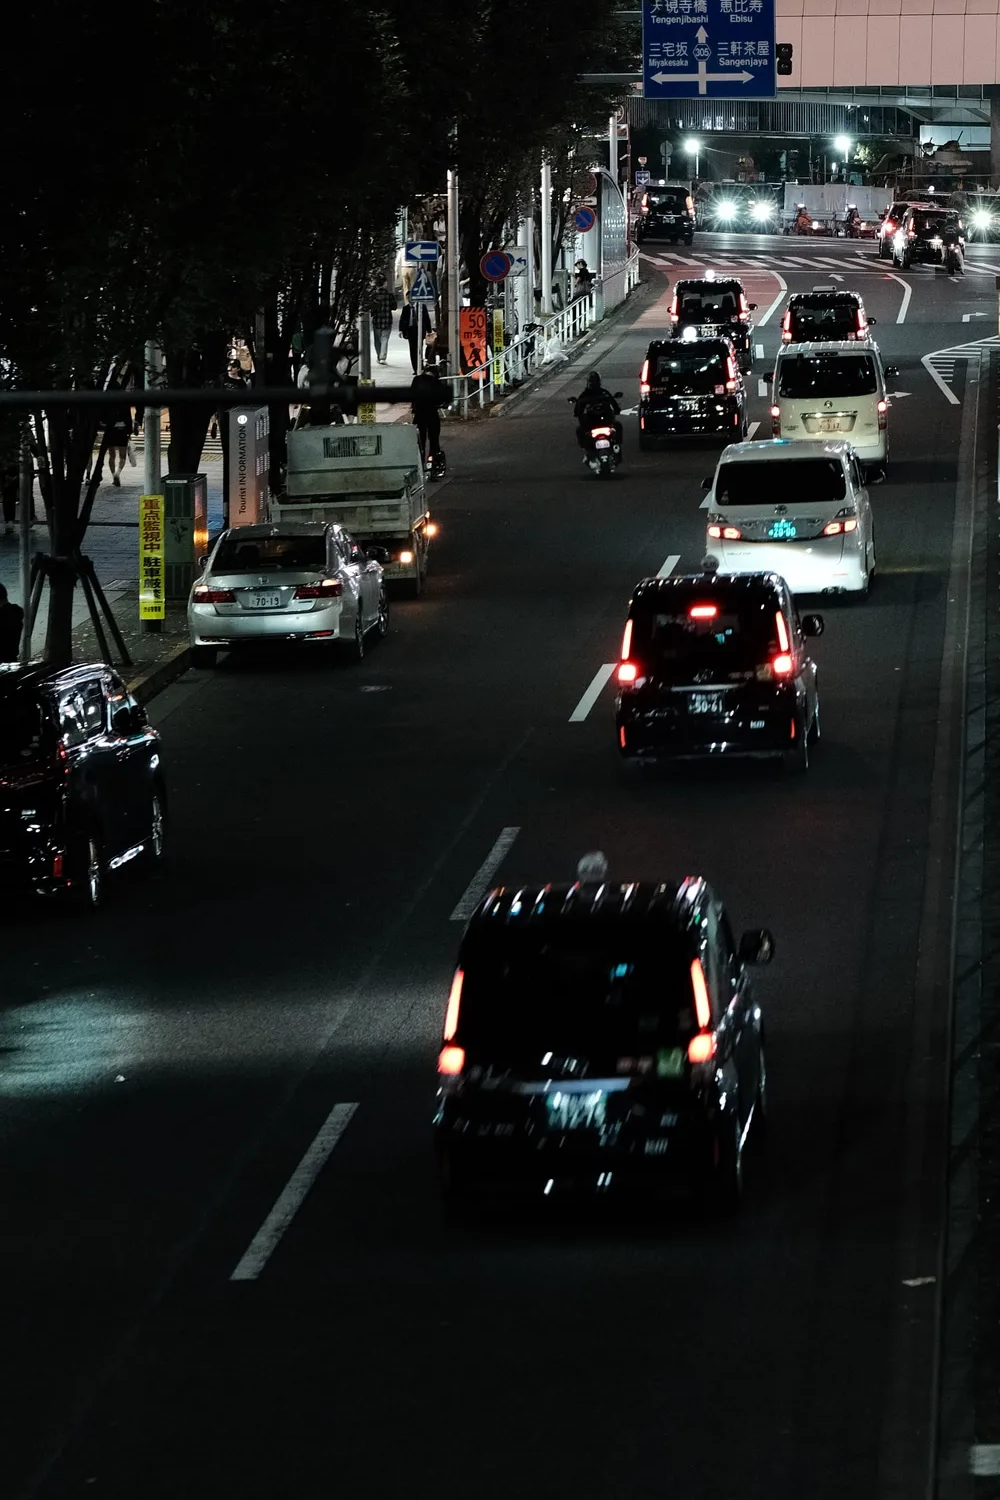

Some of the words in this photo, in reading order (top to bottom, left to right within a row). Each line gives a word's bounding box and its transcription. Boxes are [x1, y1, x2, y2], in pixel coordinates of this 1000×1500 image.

[651, 15, 709, 25] Tengenjibashi
[730, 14, 753, 23] Ebisu
[649, 42, 689, 58] 三宅坂
[694, 47, 709, 57] 305
[717, 41, 770, 56] 三軒茶屋
[649, 58, 689, 67] Miyakesaka
[719, 57, 768, 67] Sangenjaya
[469, 314, 485, 328] 50
[239, 425, 247, 485] INFORMATION
[143, 498, 161, 552] 重点監視中
[256, 596, 280, 607] 70-19
